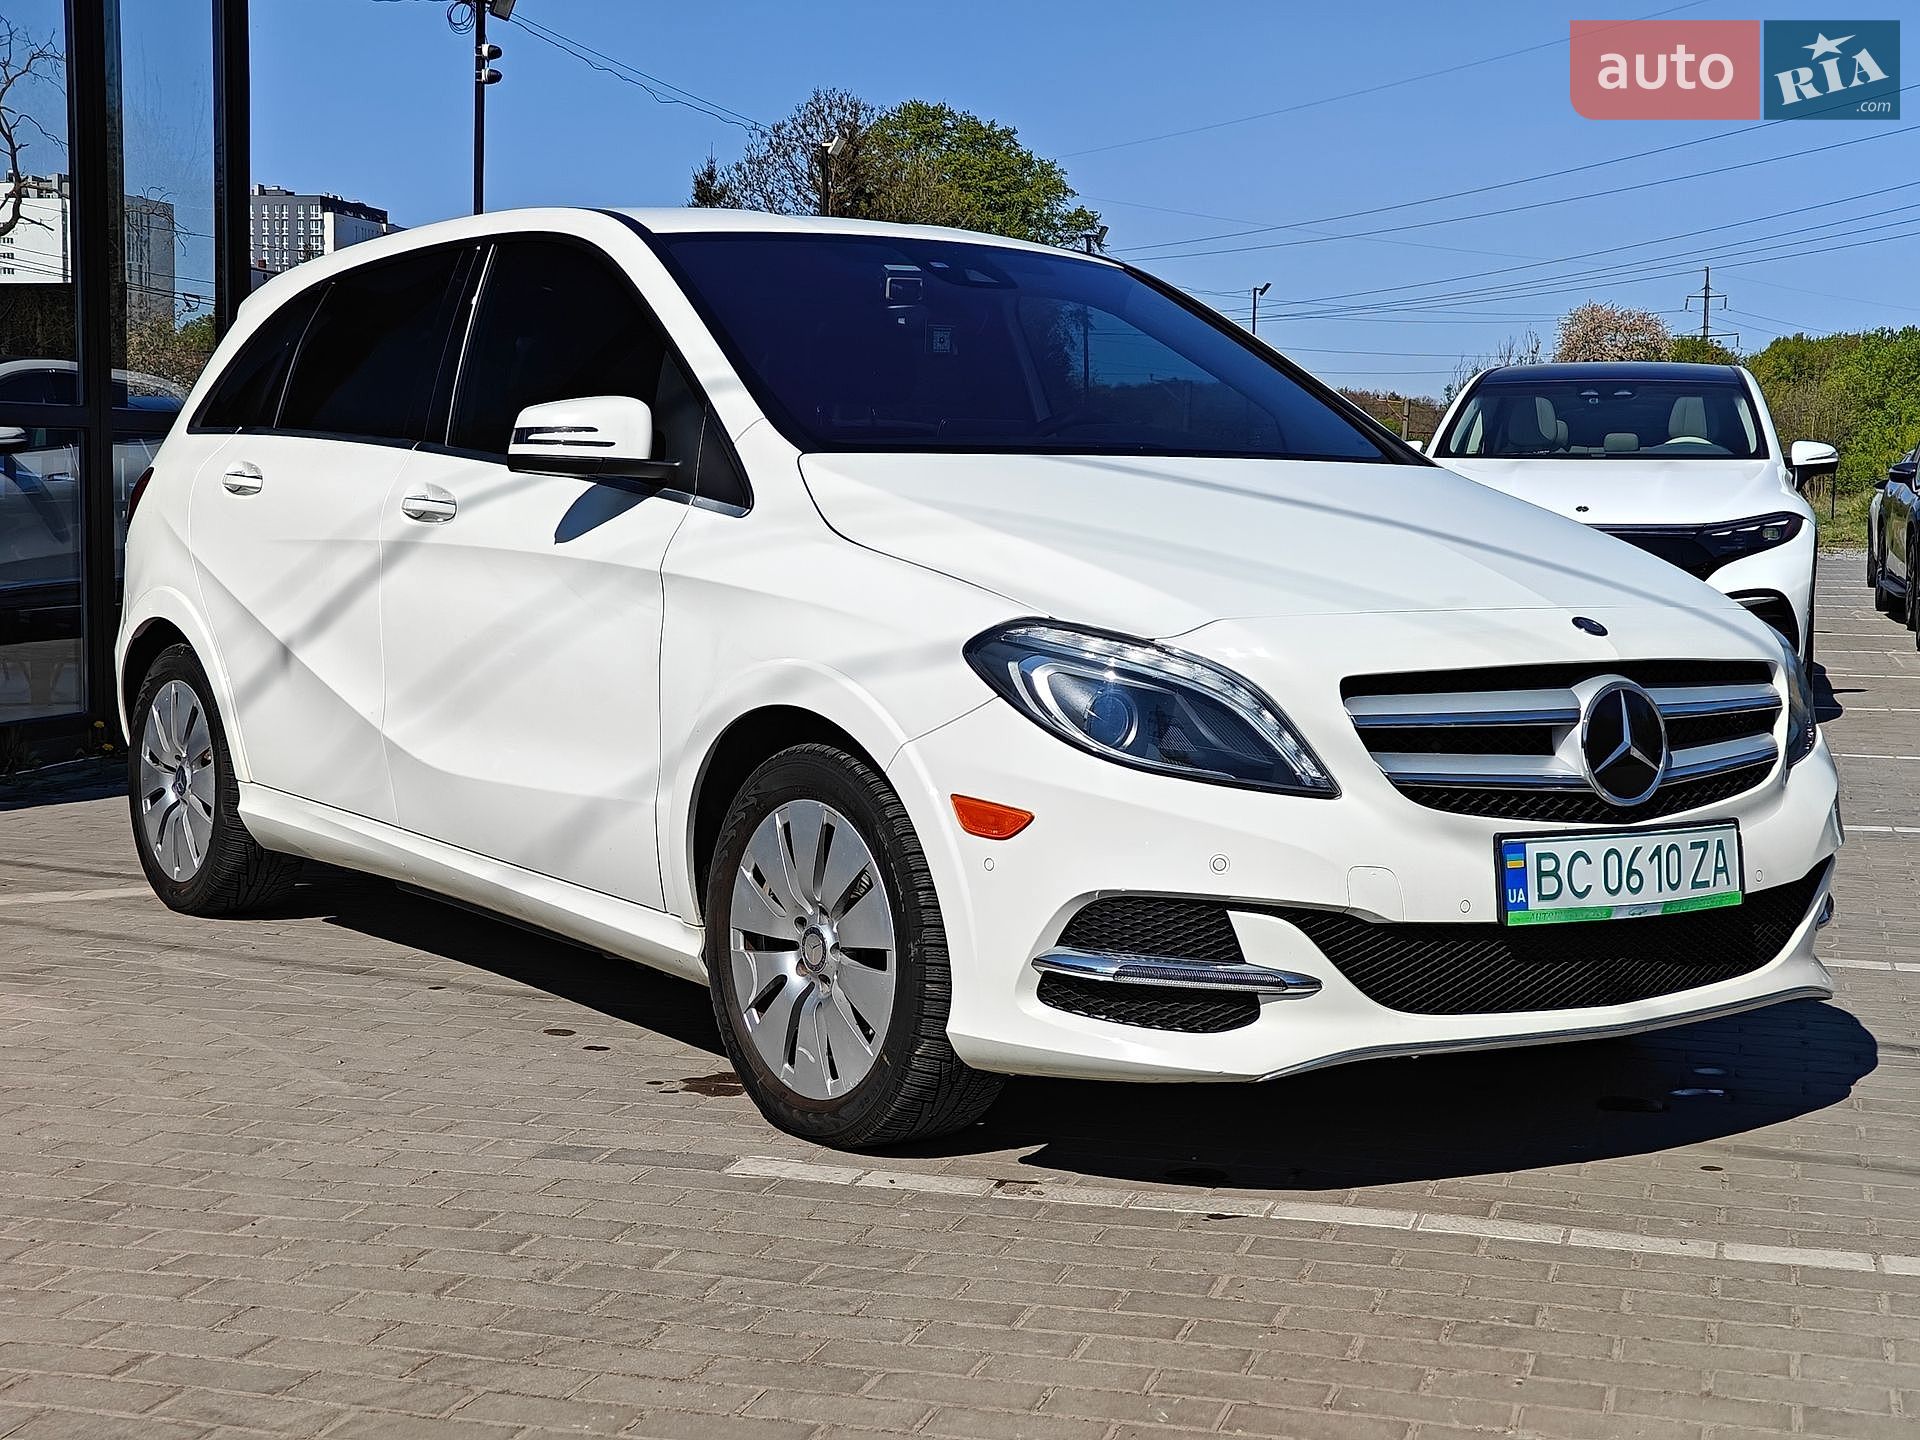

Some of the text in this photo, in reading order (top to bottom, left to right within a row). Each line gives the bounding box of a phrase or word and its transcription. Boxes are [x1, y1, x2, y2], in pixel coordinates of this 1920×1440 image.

[1535, 839, 1731, 902] BC 0610 ZA
[1508, 888, 1526, 903] UA
